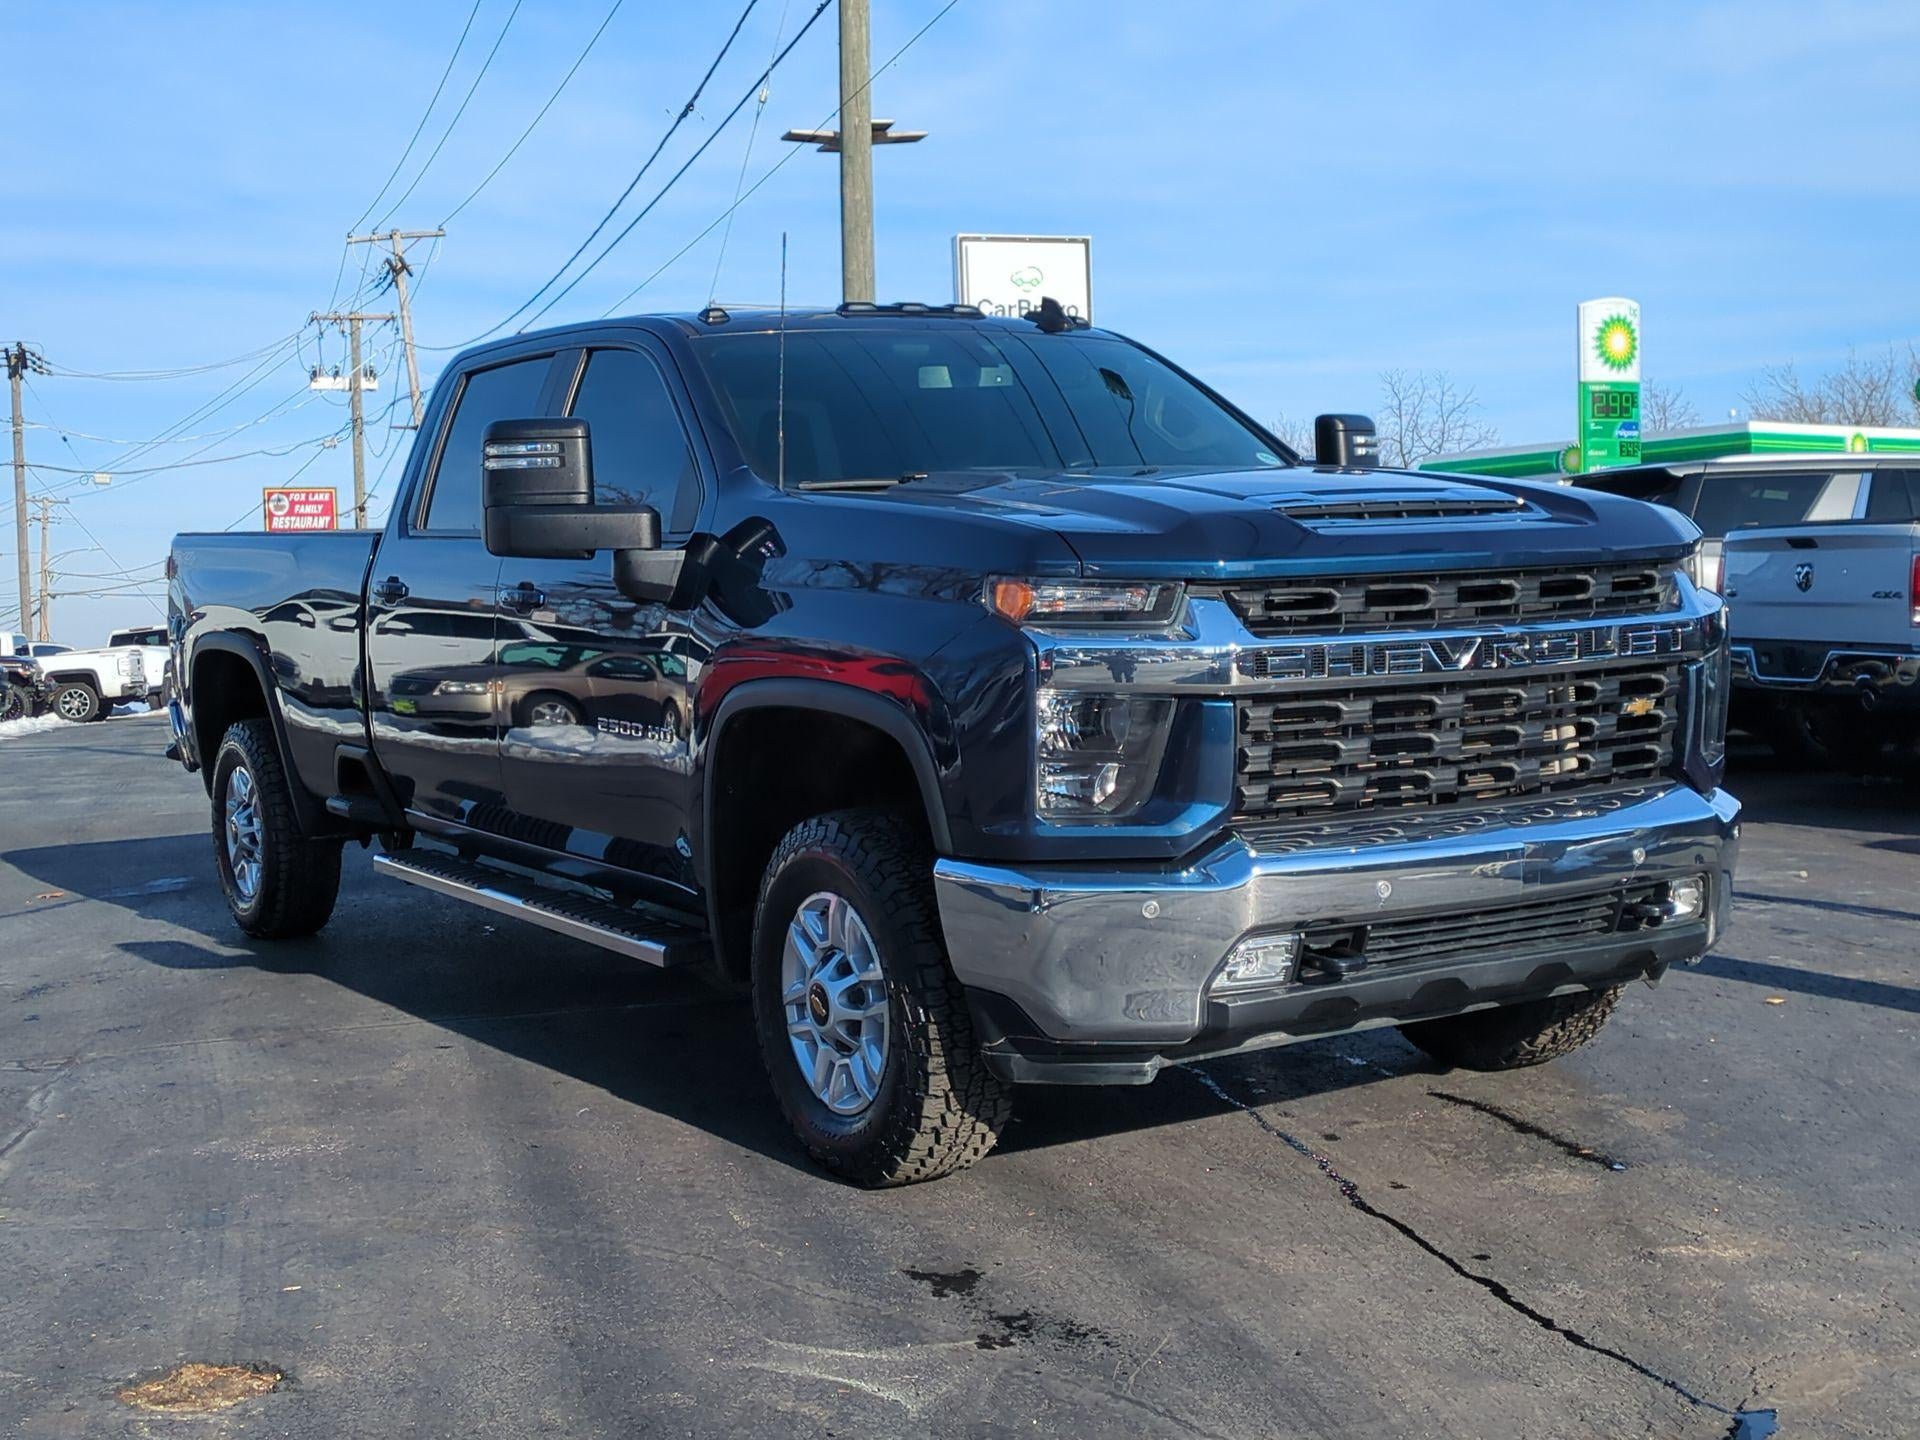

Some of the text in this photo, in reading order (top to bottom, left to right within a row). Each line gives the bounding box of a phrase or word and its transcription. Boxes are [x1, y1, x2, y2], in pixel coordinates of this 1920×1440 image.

[977, 298, 1079, 319] CarBro
[289, 493, 331, 502] FOX LAKE
[294, 504, 323, 514] FAMILY
[272, 516, 332, 529] RESTAURANT
[1254, 624, 1693, 680] CHEVROLET
[597, 716, 674, 743] 2500 HD
